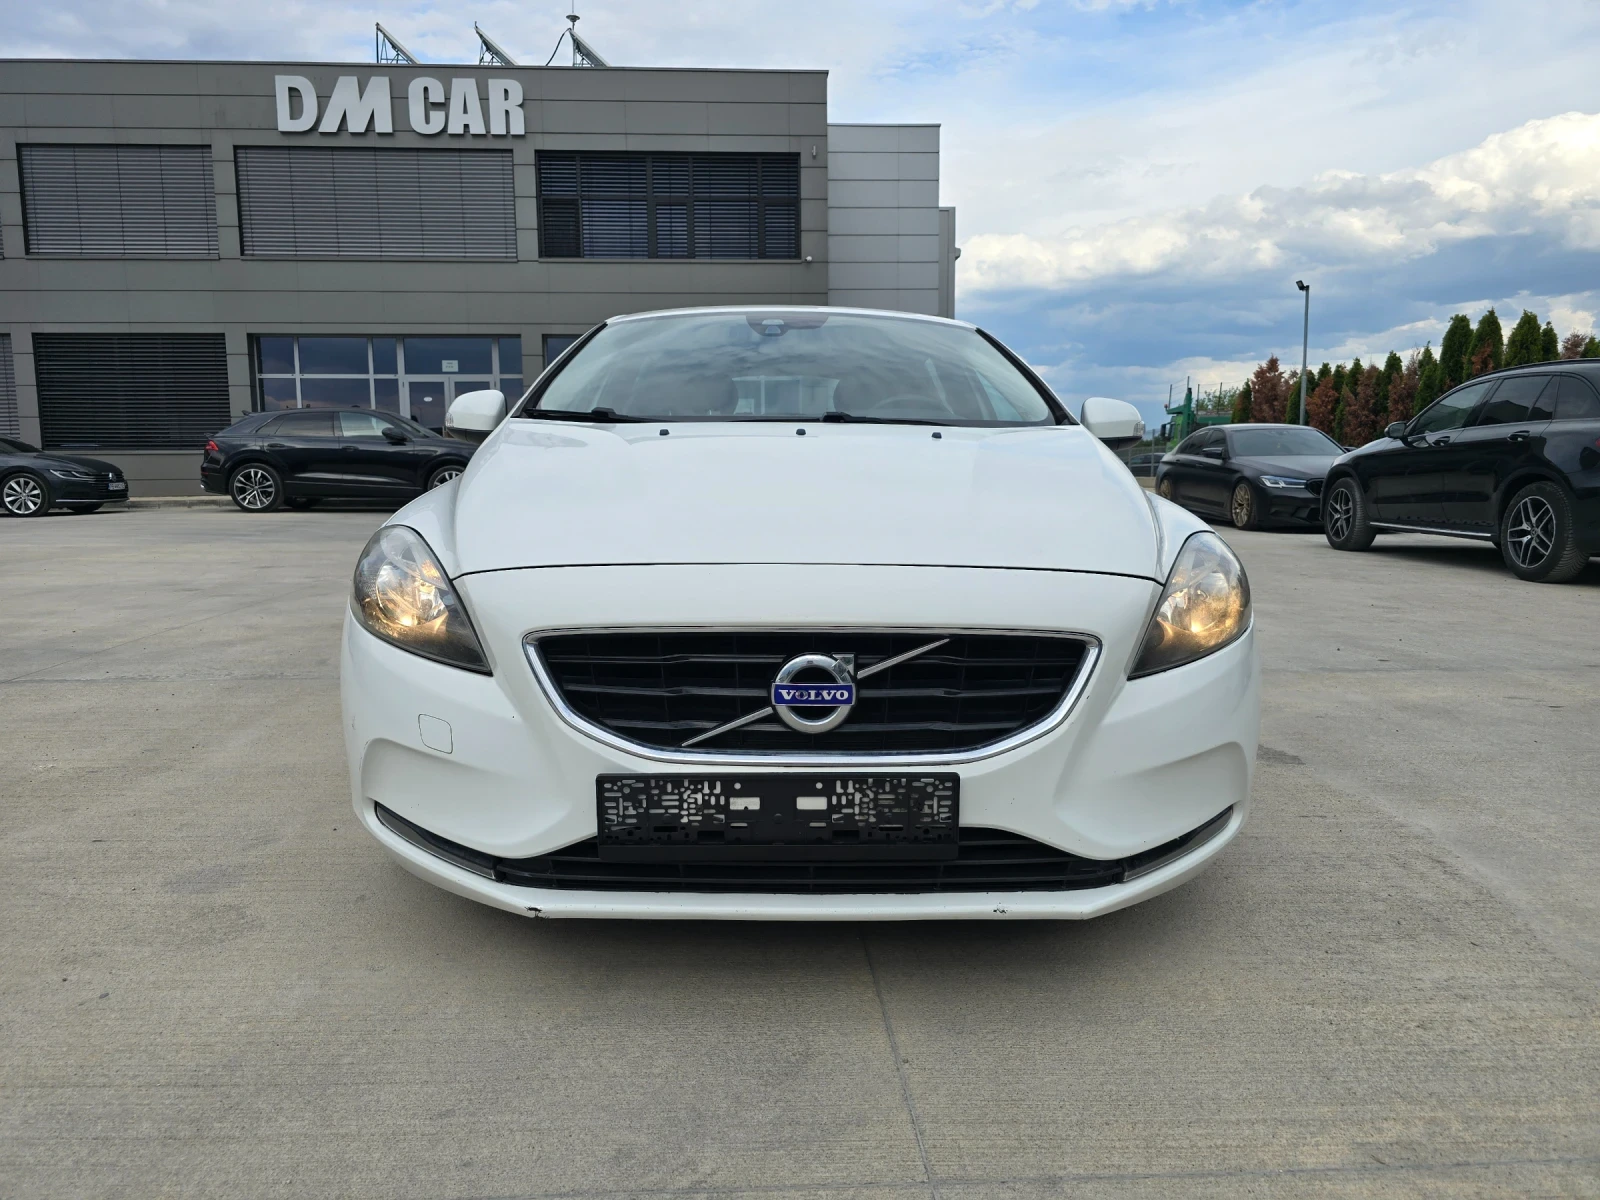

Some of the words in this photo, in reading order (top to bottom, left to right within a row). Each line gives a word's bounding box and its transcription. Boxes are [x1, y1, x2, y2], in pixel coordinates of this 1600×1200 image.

[274, 74, 394, 134] DM
[407, 76, 526, 136] CAR
[778, 689, 849, 701] VOLVO
